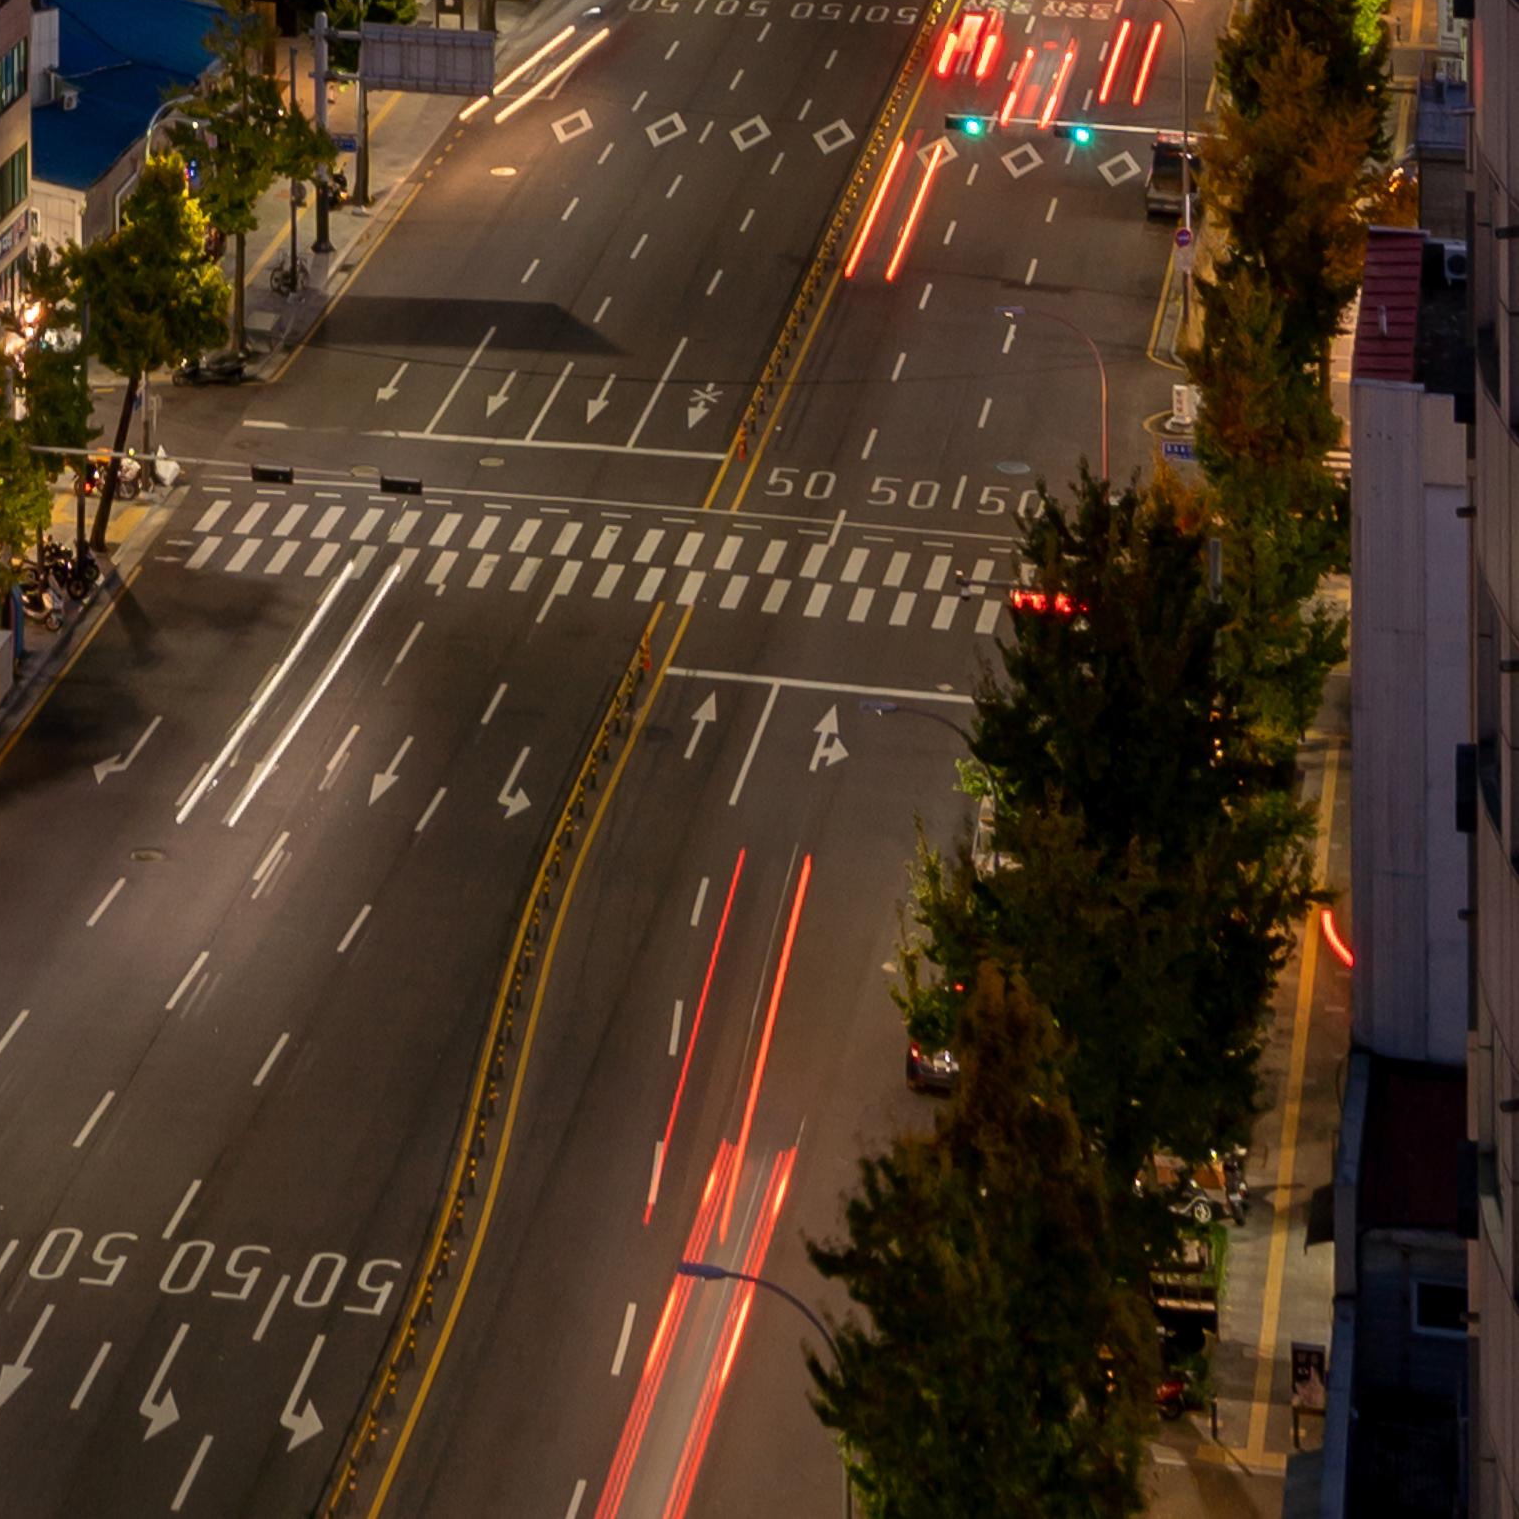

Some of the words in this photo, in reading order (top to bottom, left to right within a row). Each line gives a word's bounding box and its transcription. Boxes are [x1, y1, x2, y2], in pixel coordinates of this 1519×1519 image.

[790, 2, 843, 20] 50
[865, 5, 919, 25] 50
[764, 467, 837, 500] 50
[866, 475, 941, 510] 50
[976, 485, 1048, 519] 50
[28, 1227, 139, 1287] 50
[158, 1239, 271, 1300] 50
[293, 1252, 402, 1316] 50
